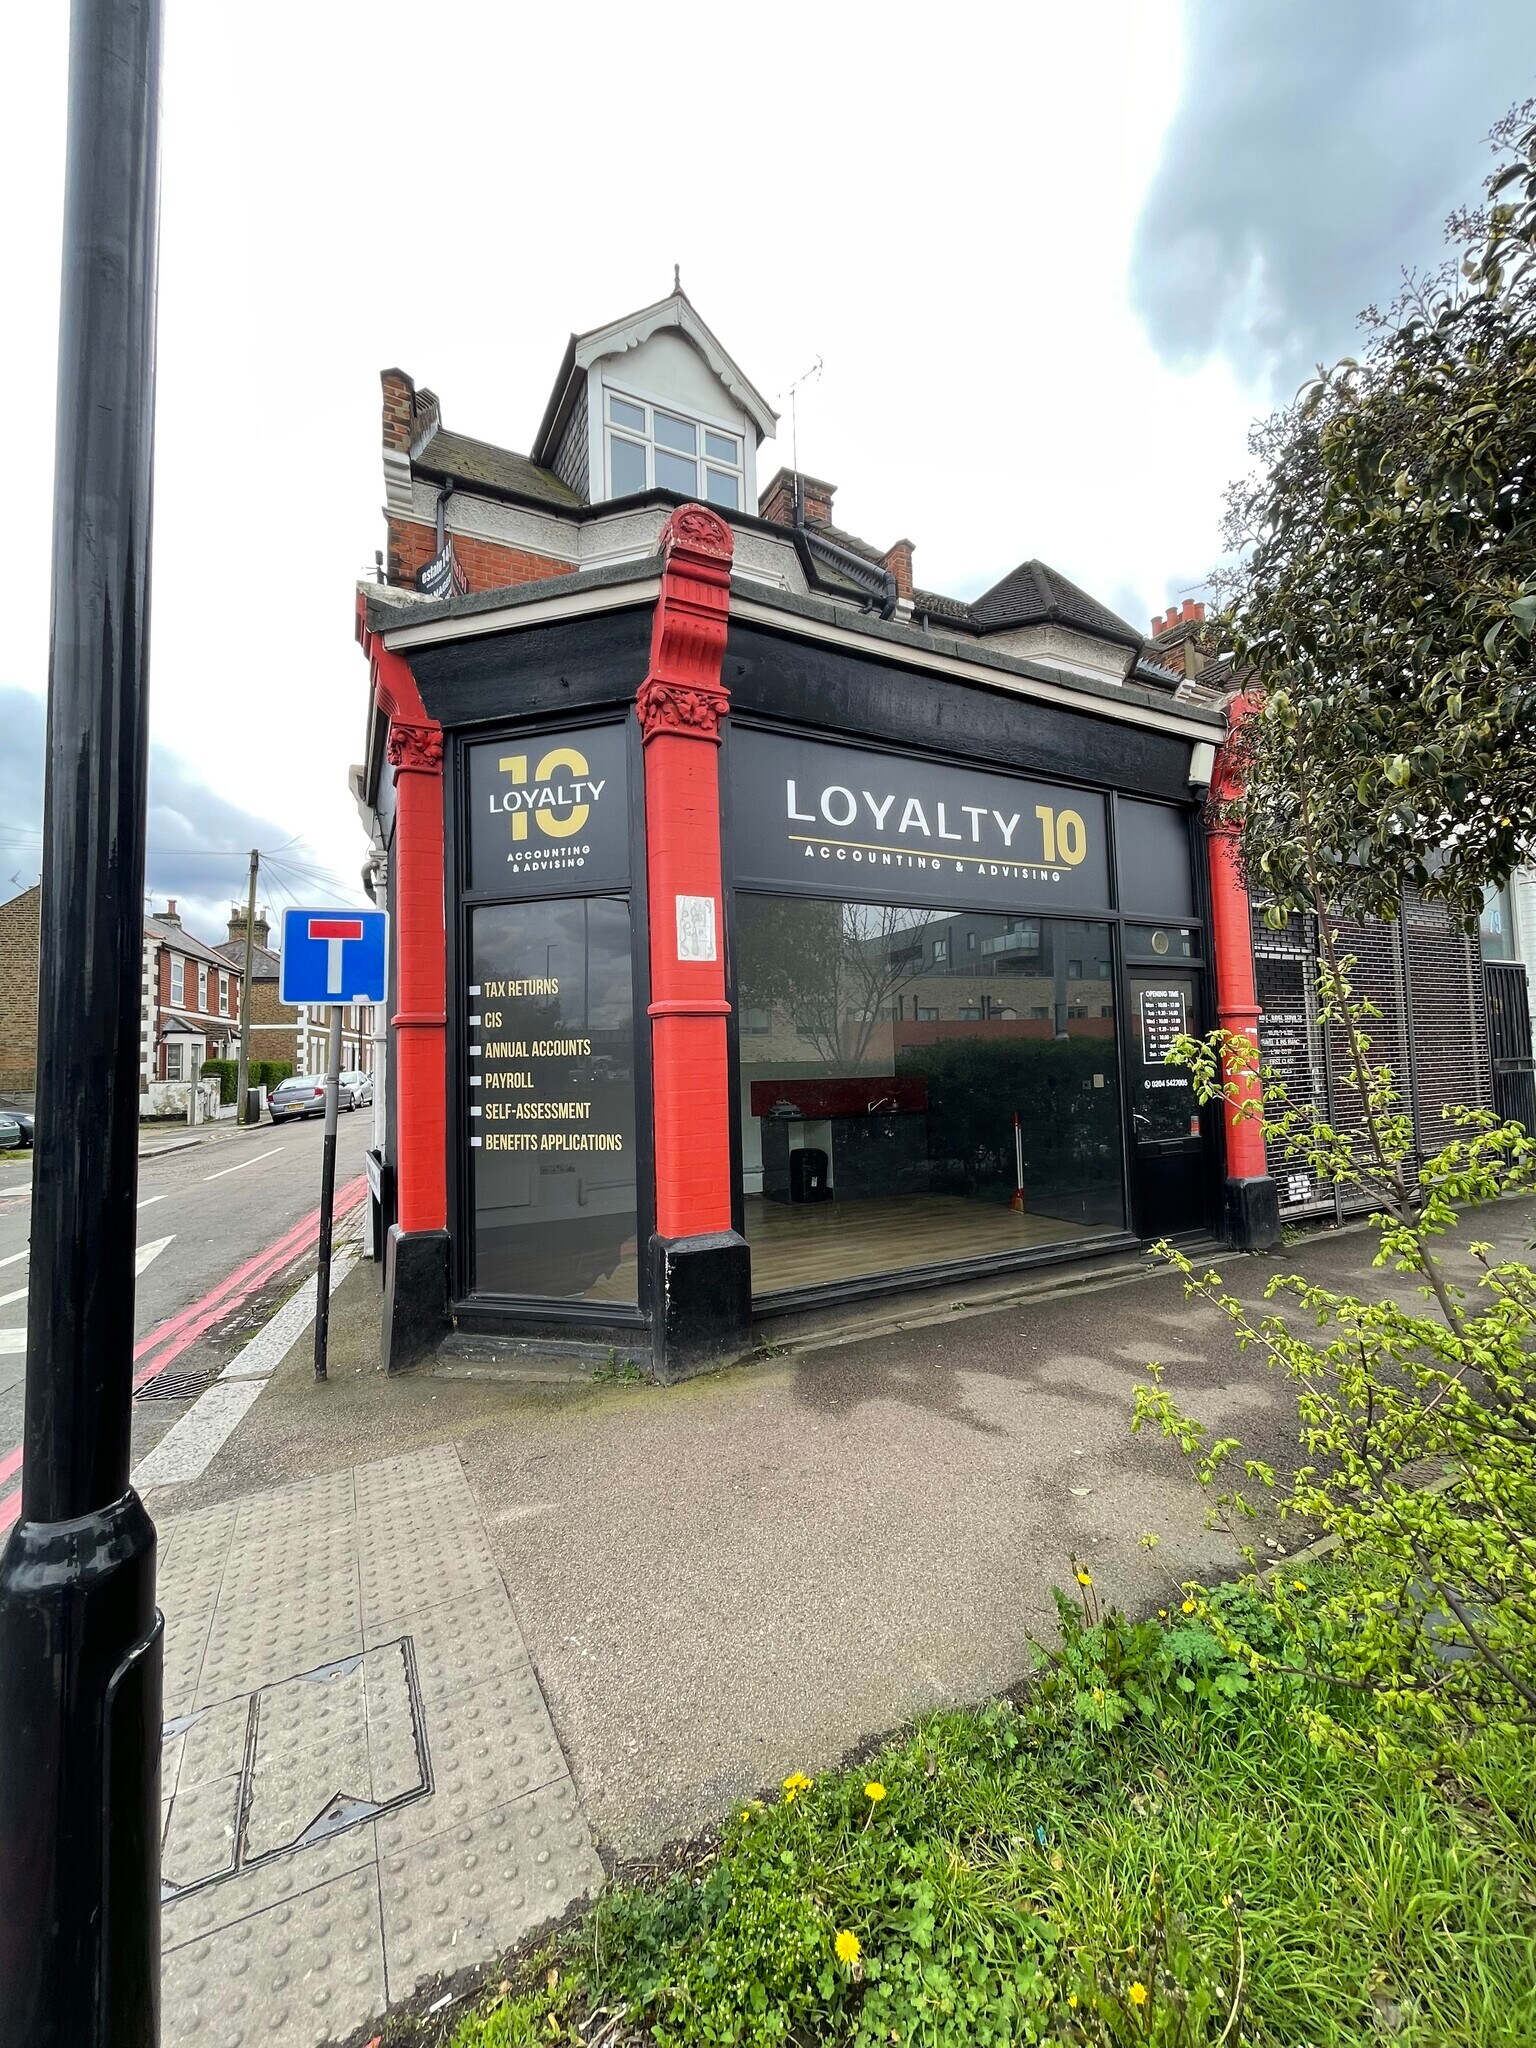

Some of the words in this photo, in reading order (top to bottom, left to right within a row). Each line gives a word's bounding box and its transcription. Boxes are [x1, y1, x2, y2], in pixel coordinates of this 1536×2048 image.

[490, 780, 605, 813] LOYALTY
[499, 748, 589, 840] 10
[786, 779, 1021, 847] LOYALTY
[1035, 805, 1087, 865] 10
[507, 845, 590, 862] ACCOUNTING
[513, 864, 519, 873] &
[524, 858, 585, 872] ADVISING
[804, 845, 941, 870] ACCOUNTING
[956, 861, 964, 872] &
[978, 863, 1061, 882] ADVISING
[484, 981, 506, 998] TAX
[508, 978, 559, 997] RETURNS
[1145, 990, 1168, 998] OPENING
[1168, 990, 1180, 998] TIME
[485, 1012, 503, 1028] CIS
[485, 1041, 529, 1059] ANNUAL
[531, 1039, 591, 1057] ACCOUNTS
[485, 1072, 534, 1089] PAYROLL
[1151, 1079, 1165, 1088] 0204
[485, 1102, 591, 1120] SELF-ASSESSMENT
[485, 1134, 538, 1151] BENEFITS
[540, 1134, 623, 1151] APPLICATIONS
